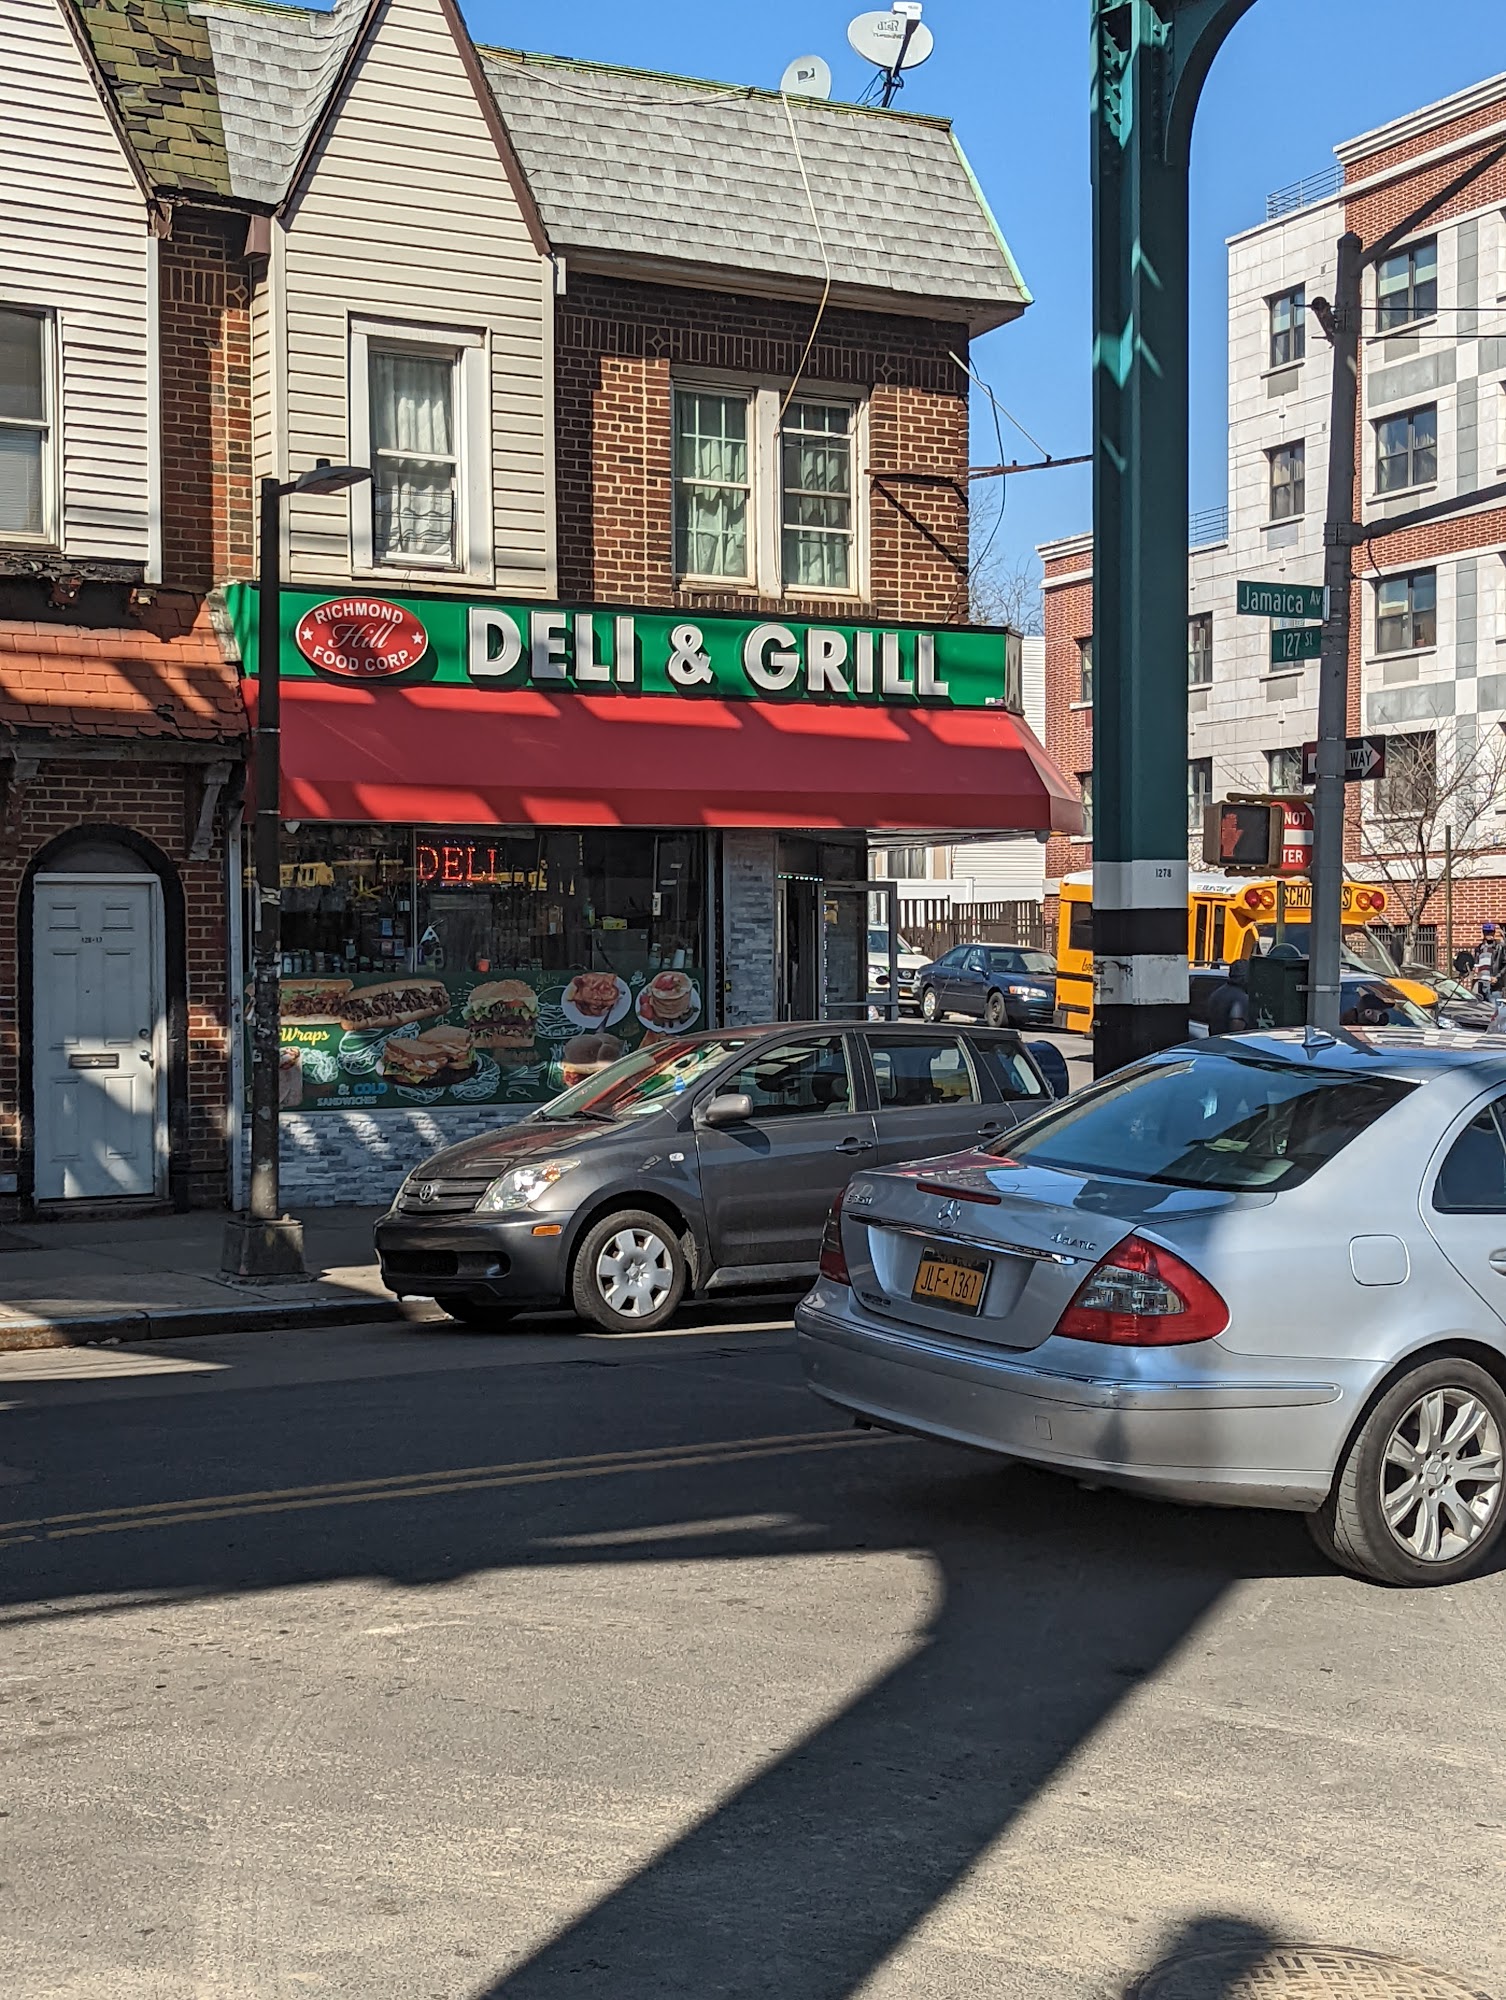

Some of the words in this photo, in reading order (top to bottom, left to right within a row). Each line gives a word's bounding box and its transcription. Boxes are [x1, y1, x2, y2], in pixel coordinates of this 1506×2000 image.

[1240, 586, 1304, 614] Jamaica
[1309, 590, 1322, 606] Av
[314, 602, 403, 624] RICHMOND
[327, 622, 396, 648] Hill
[1282, 632, 1301, 658] 127
[1304, 631, 1313, 647] St
[312, 645, 358, 670] FOOD
[365, 650, 413, 671] CORP.
[468, 606, 635, 683] DELI
[668, 624, 714, 686] &
[744, 623, 949, 696] GRILL
[1350, 749, 1373, 768] WAY
[1284, 811, 1307, 826] NOT
[416, 846, 498, 882] DELI
[1282, 849, 1304, 864] TER
[1284, 886, 1311, 907] SCHO
[280, 1026, 331, 1046] Wraps
[338, 1083, 350, 1096] &
[353, 1082, 388, 1095] COLD
[316, 1096, 378, 1107] SANDWICHES
